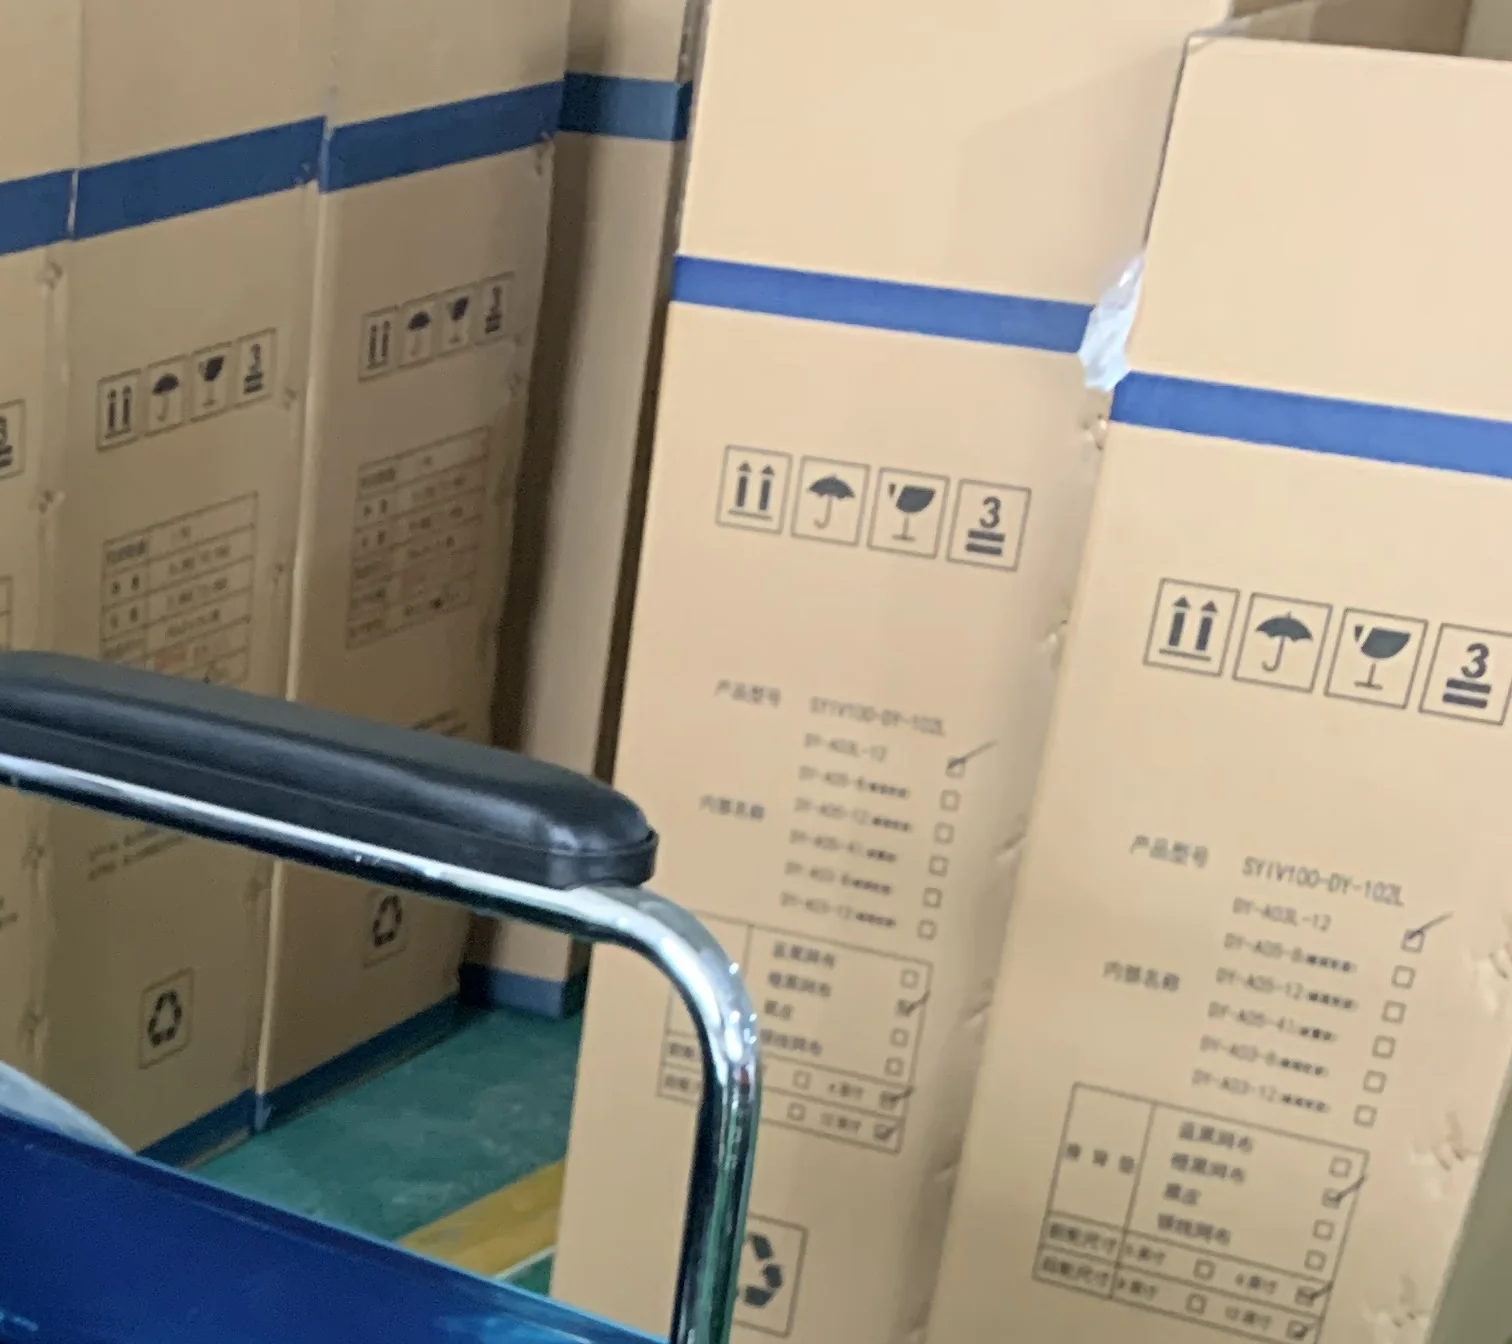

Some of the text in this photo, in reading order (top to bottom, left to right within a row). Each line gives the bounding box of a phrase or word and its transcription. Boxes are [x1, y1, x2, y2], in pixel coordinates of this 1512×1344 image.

[978, 496, 1003, 530] 3
[1460, 641, 1489, 680] 3
[1130, 834, 1210, 869] 产品型号
